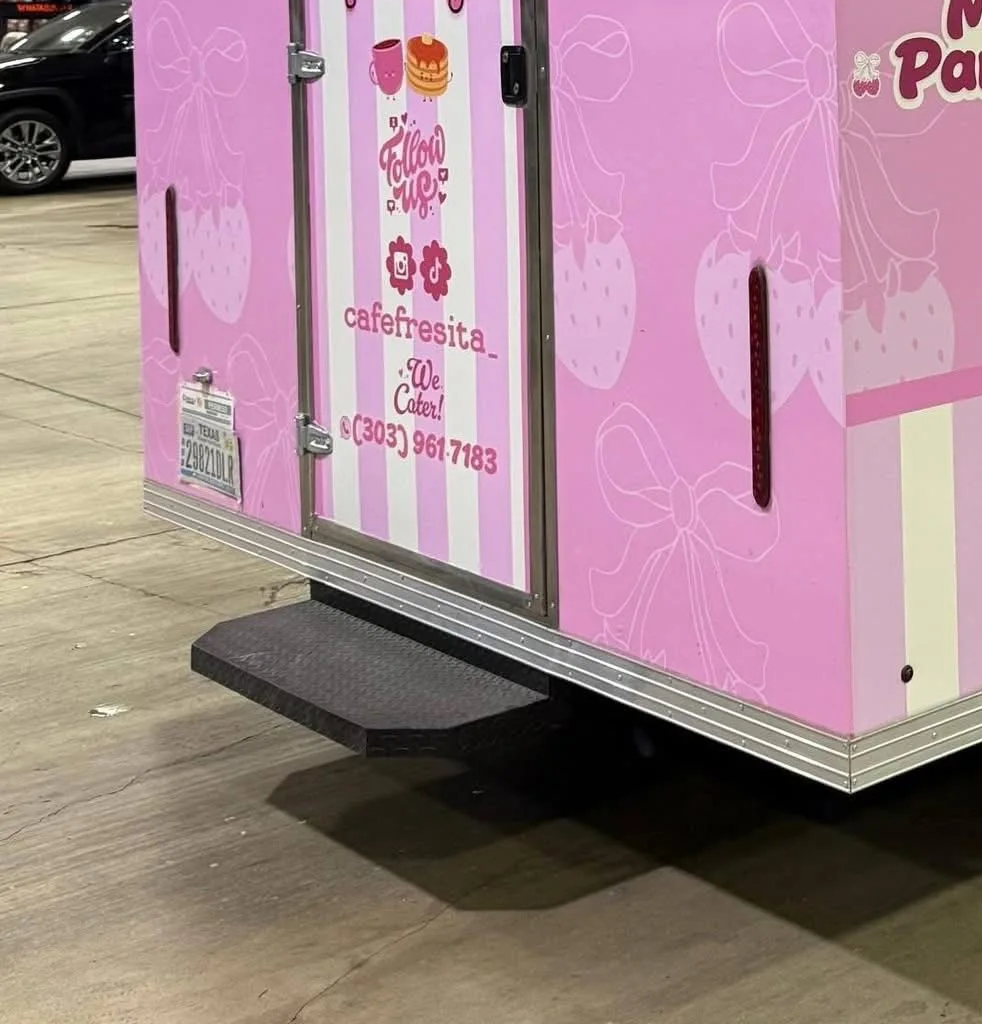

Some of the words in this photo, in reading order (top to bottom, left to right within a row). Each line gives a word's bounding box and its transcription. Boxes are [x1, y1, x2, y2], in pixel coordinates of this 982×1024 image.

[379, 124, 445, 186] Follow
[344, 301, 498, 359] cafefresita_
[406, 358, 440, 391] We
[394, 383, 444, 421] Cater!
[352, 414, 408, 459] (303)
